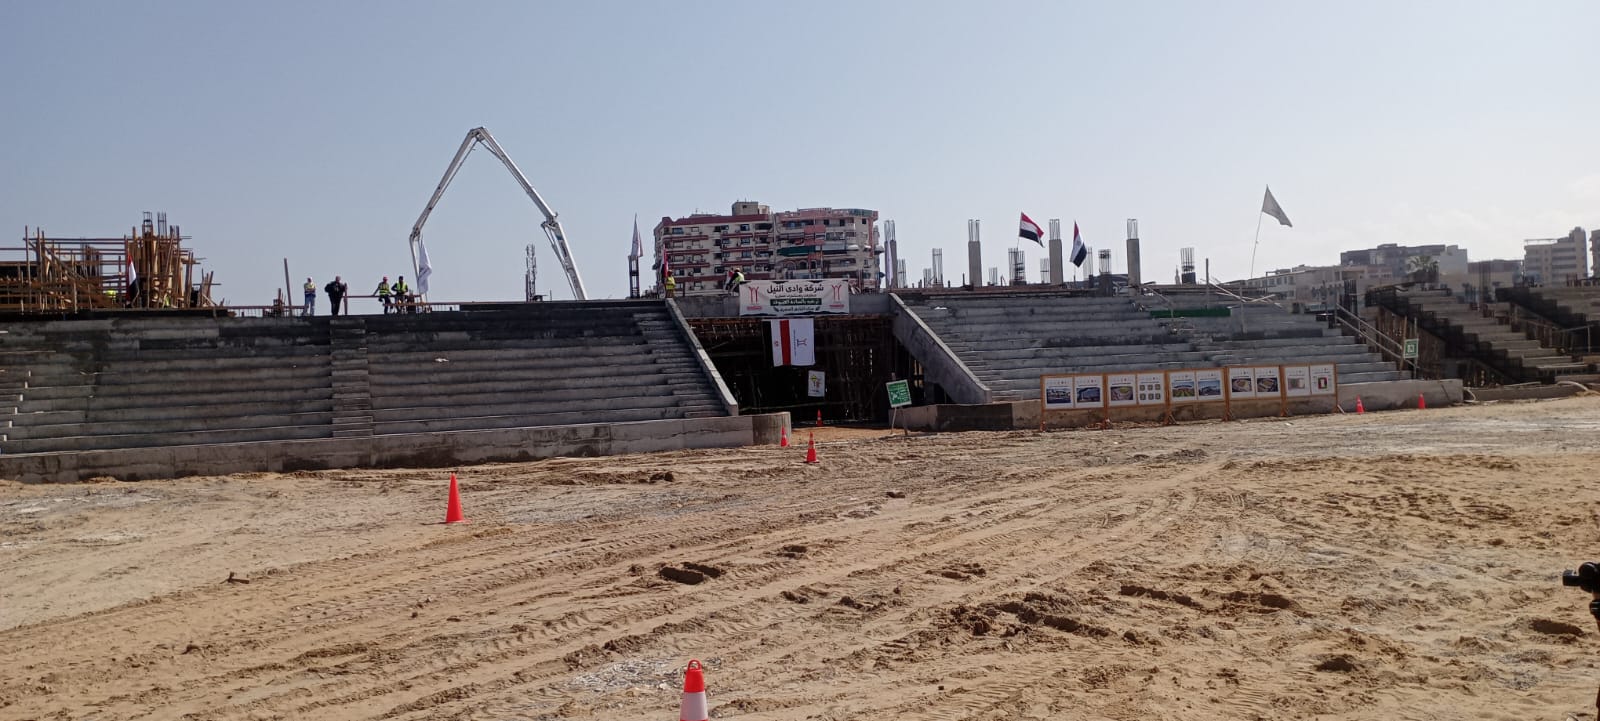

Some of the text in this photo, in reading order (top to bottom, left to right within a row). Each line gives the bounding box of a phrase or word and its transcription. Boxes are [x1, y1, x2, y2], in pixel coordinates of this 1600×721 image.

[766, 284, 824, 294] شركة وادى النيل
